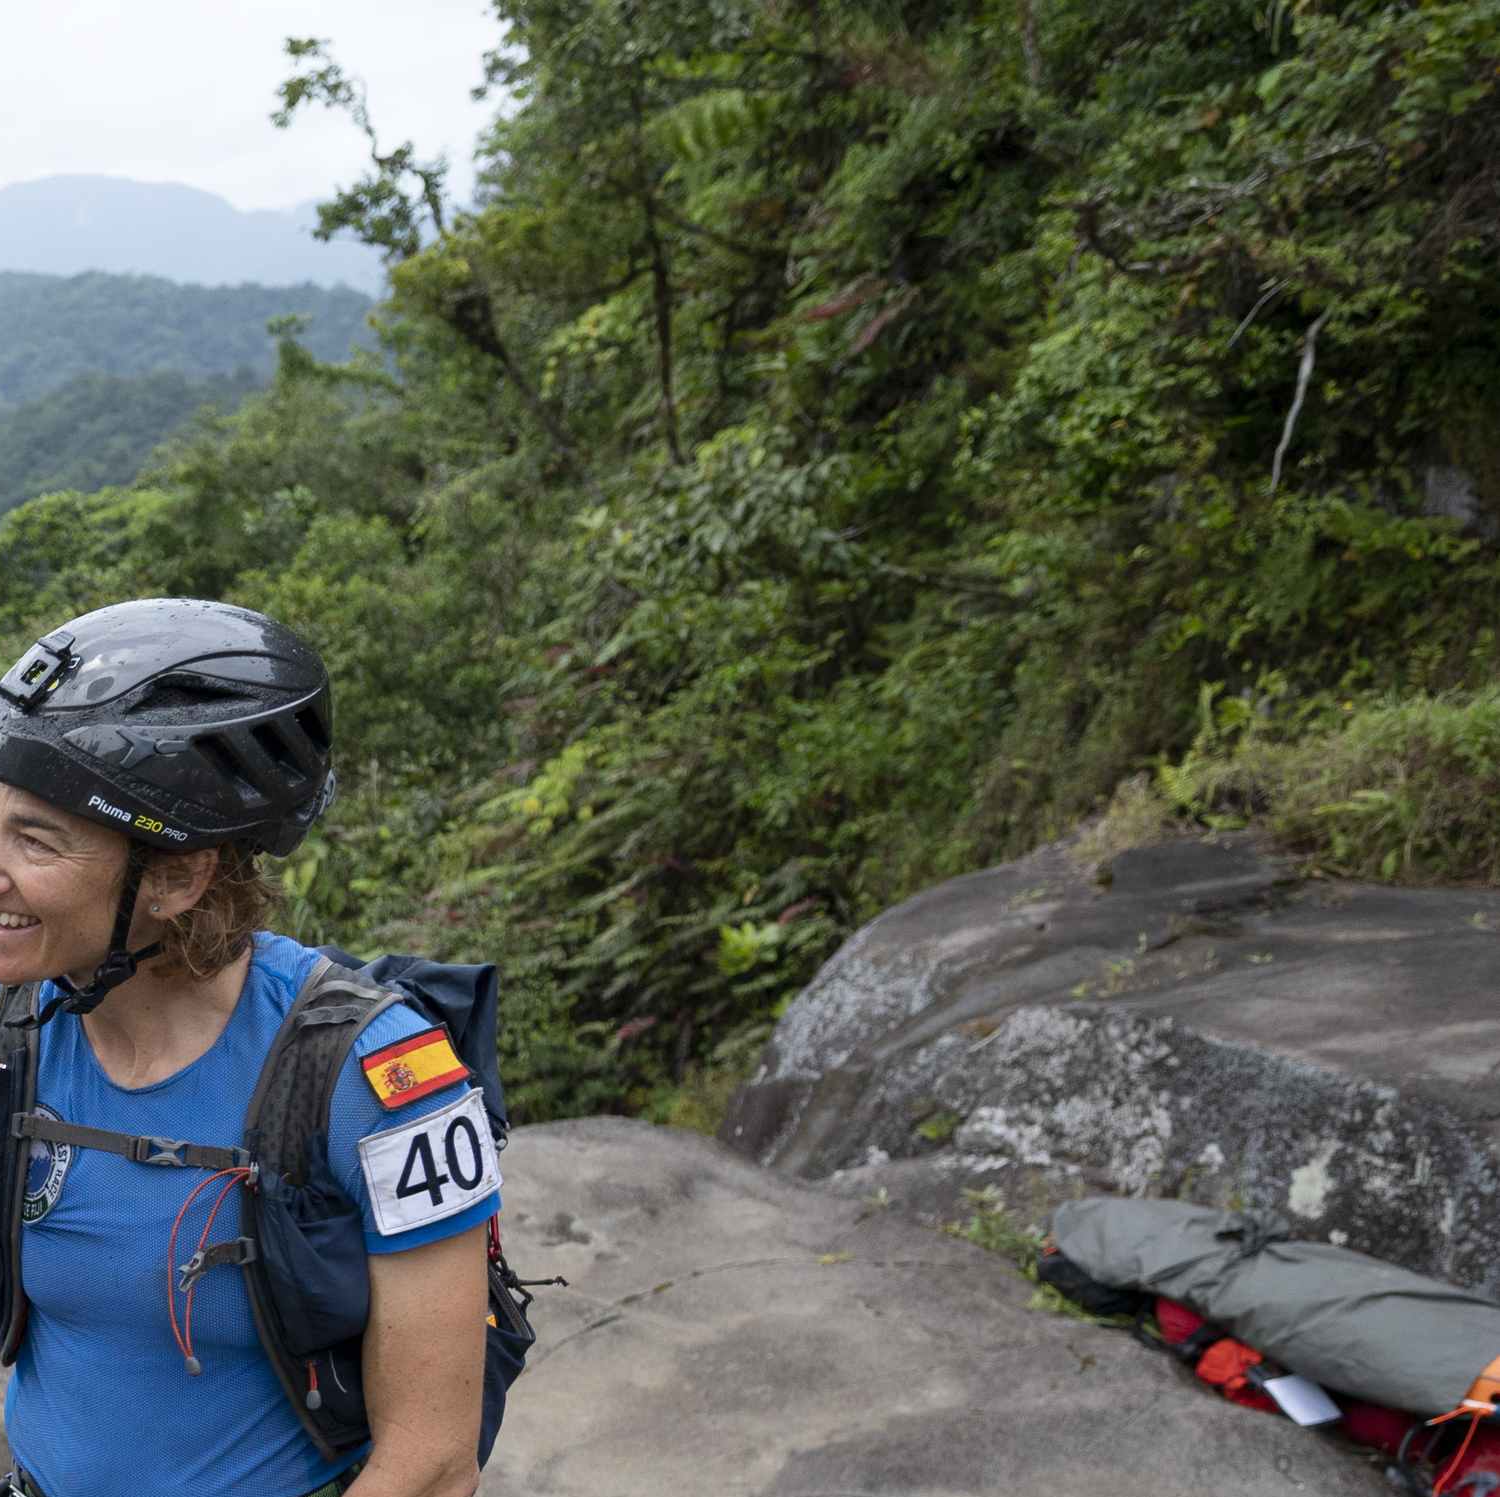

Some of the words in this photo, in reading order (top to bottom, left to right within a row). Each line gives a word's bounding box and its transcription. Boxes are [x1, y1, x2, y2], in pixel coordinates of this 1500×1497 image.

[87, 794, 132, 823] Piuma
[134, 814, 163, 833] 230
[161, 827, 188, 842] PRO
[48, 1169, 64, 1200] RACE
[395, 1115, 484, 1207] 40
